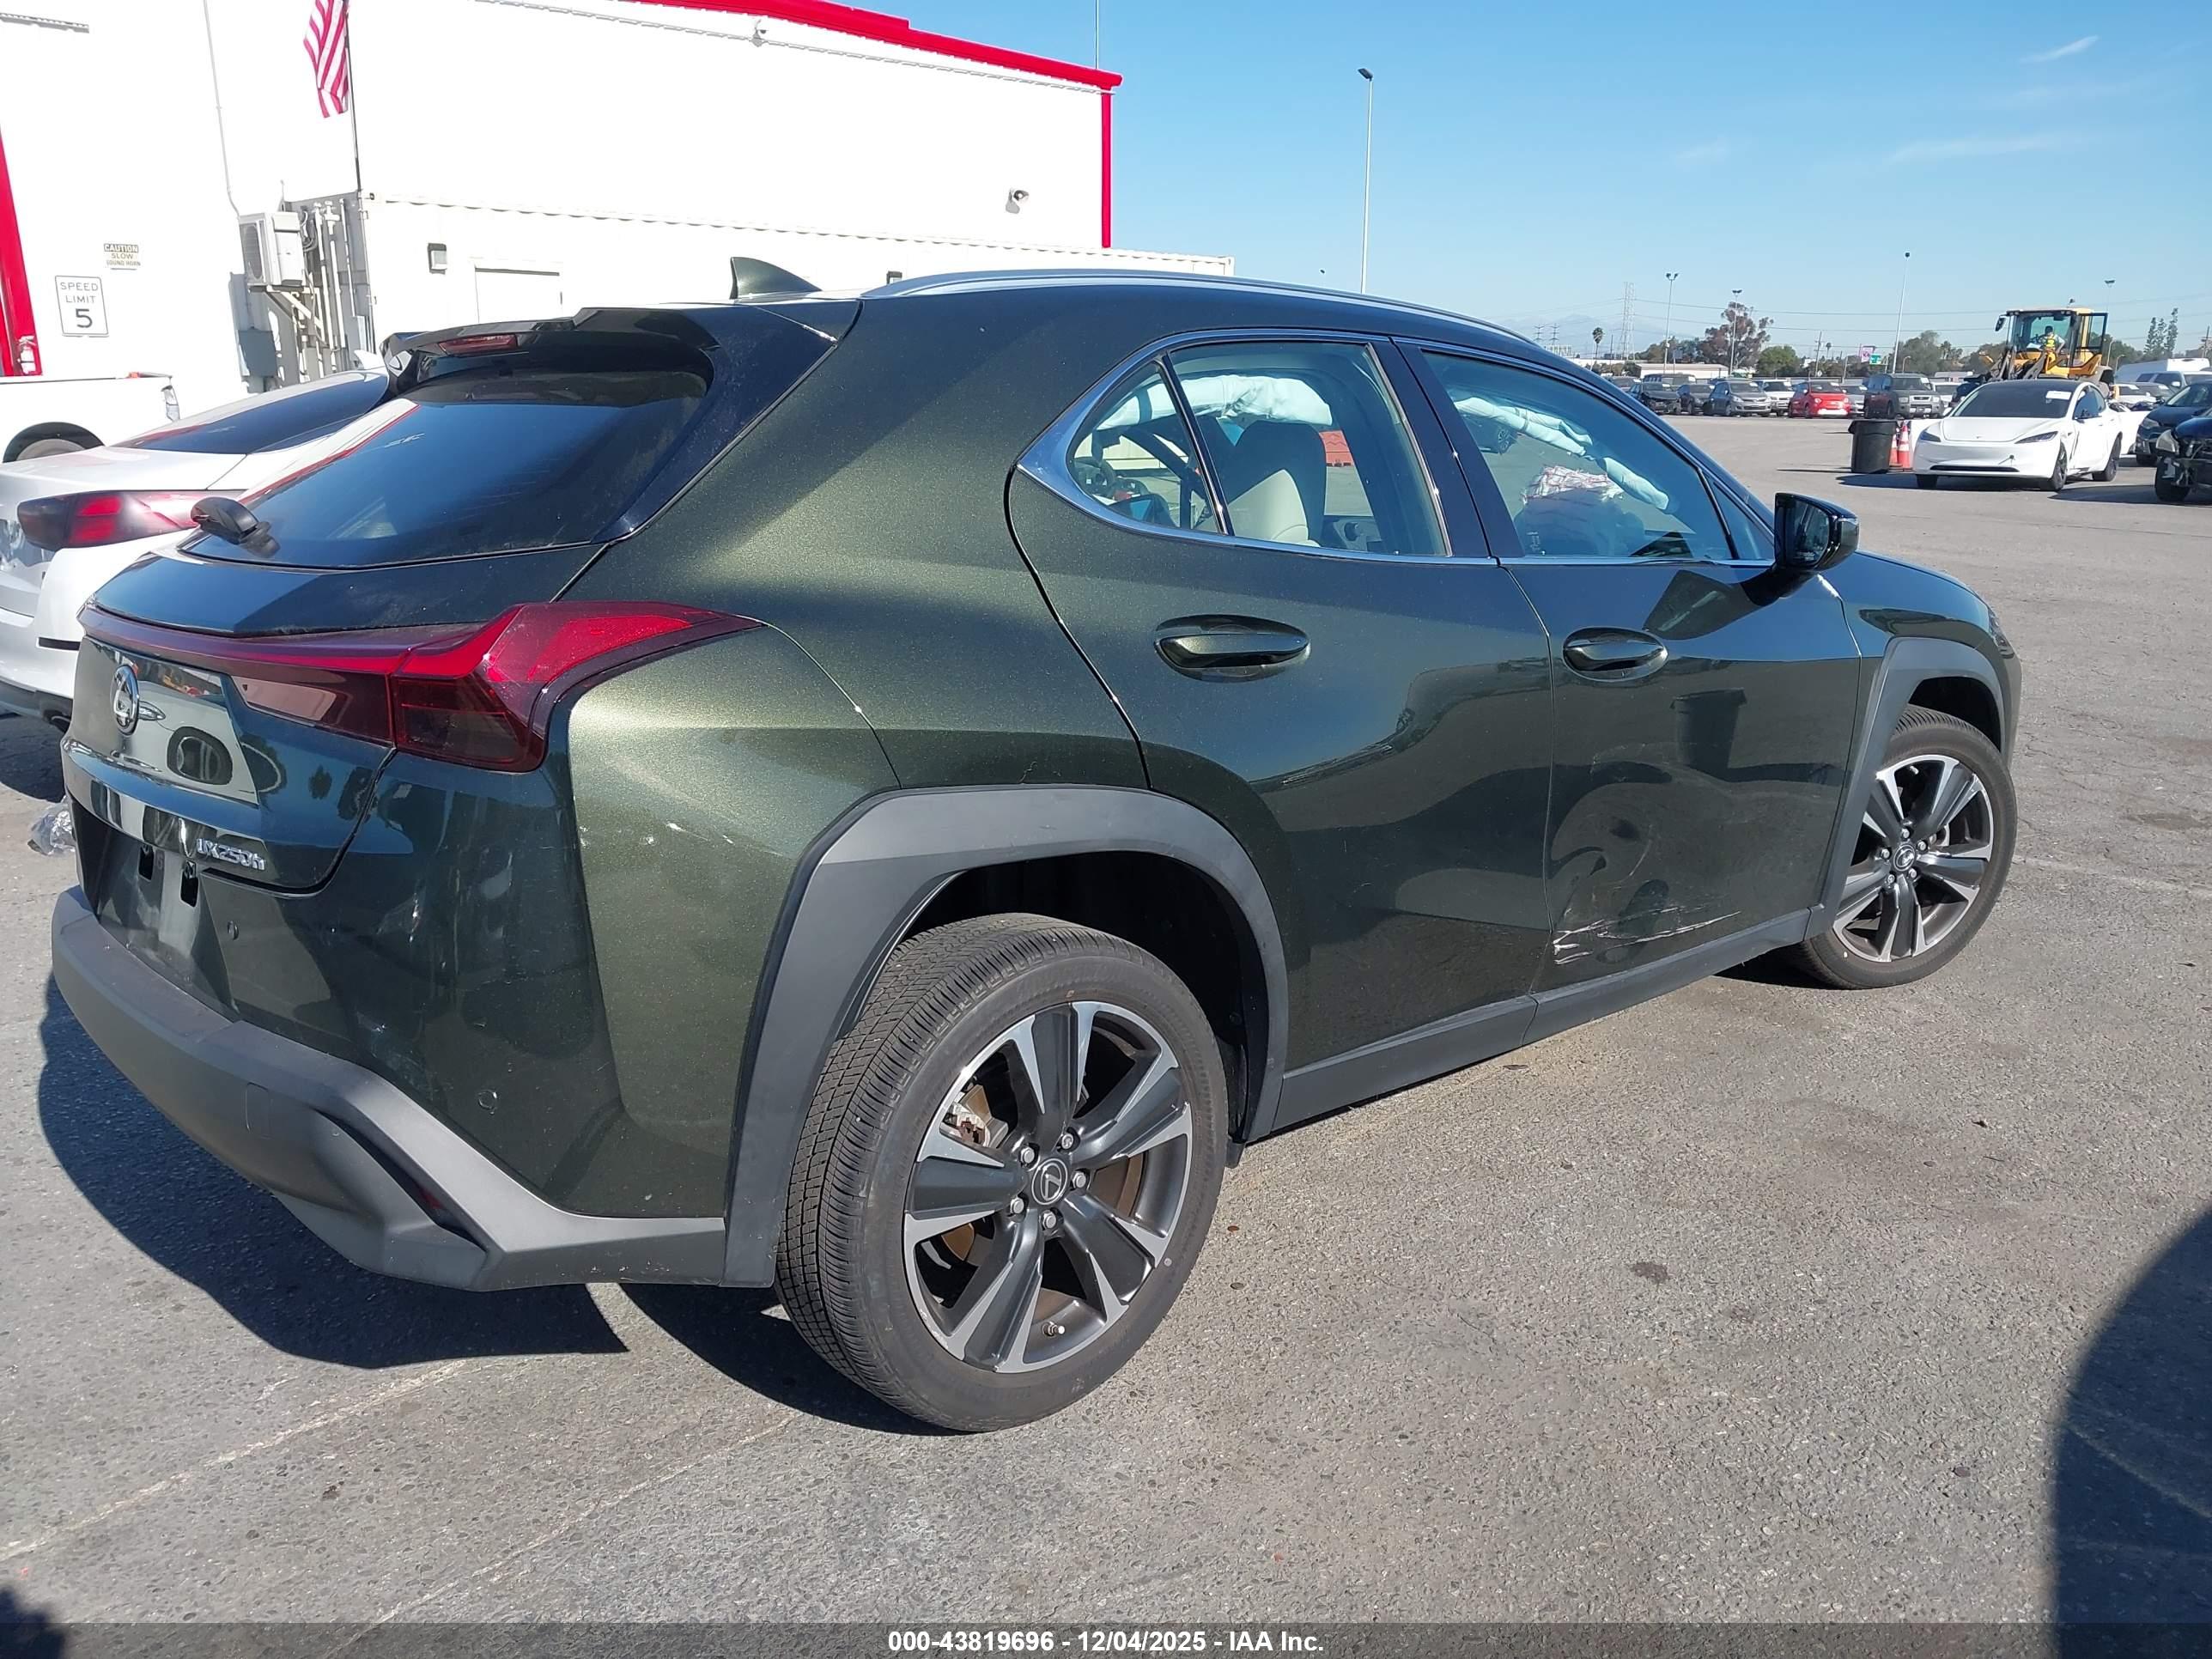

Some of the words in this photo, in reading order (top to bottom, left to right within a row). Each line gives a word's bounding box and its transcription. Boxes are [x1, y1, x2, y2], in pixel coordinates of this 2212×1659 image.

[104, 244, 138, 252] CAUTION
[60, 282, 99, 291] SPEED
[65, 295, 96, 303] LIMIT
[75, 308, 93, 328] 5
